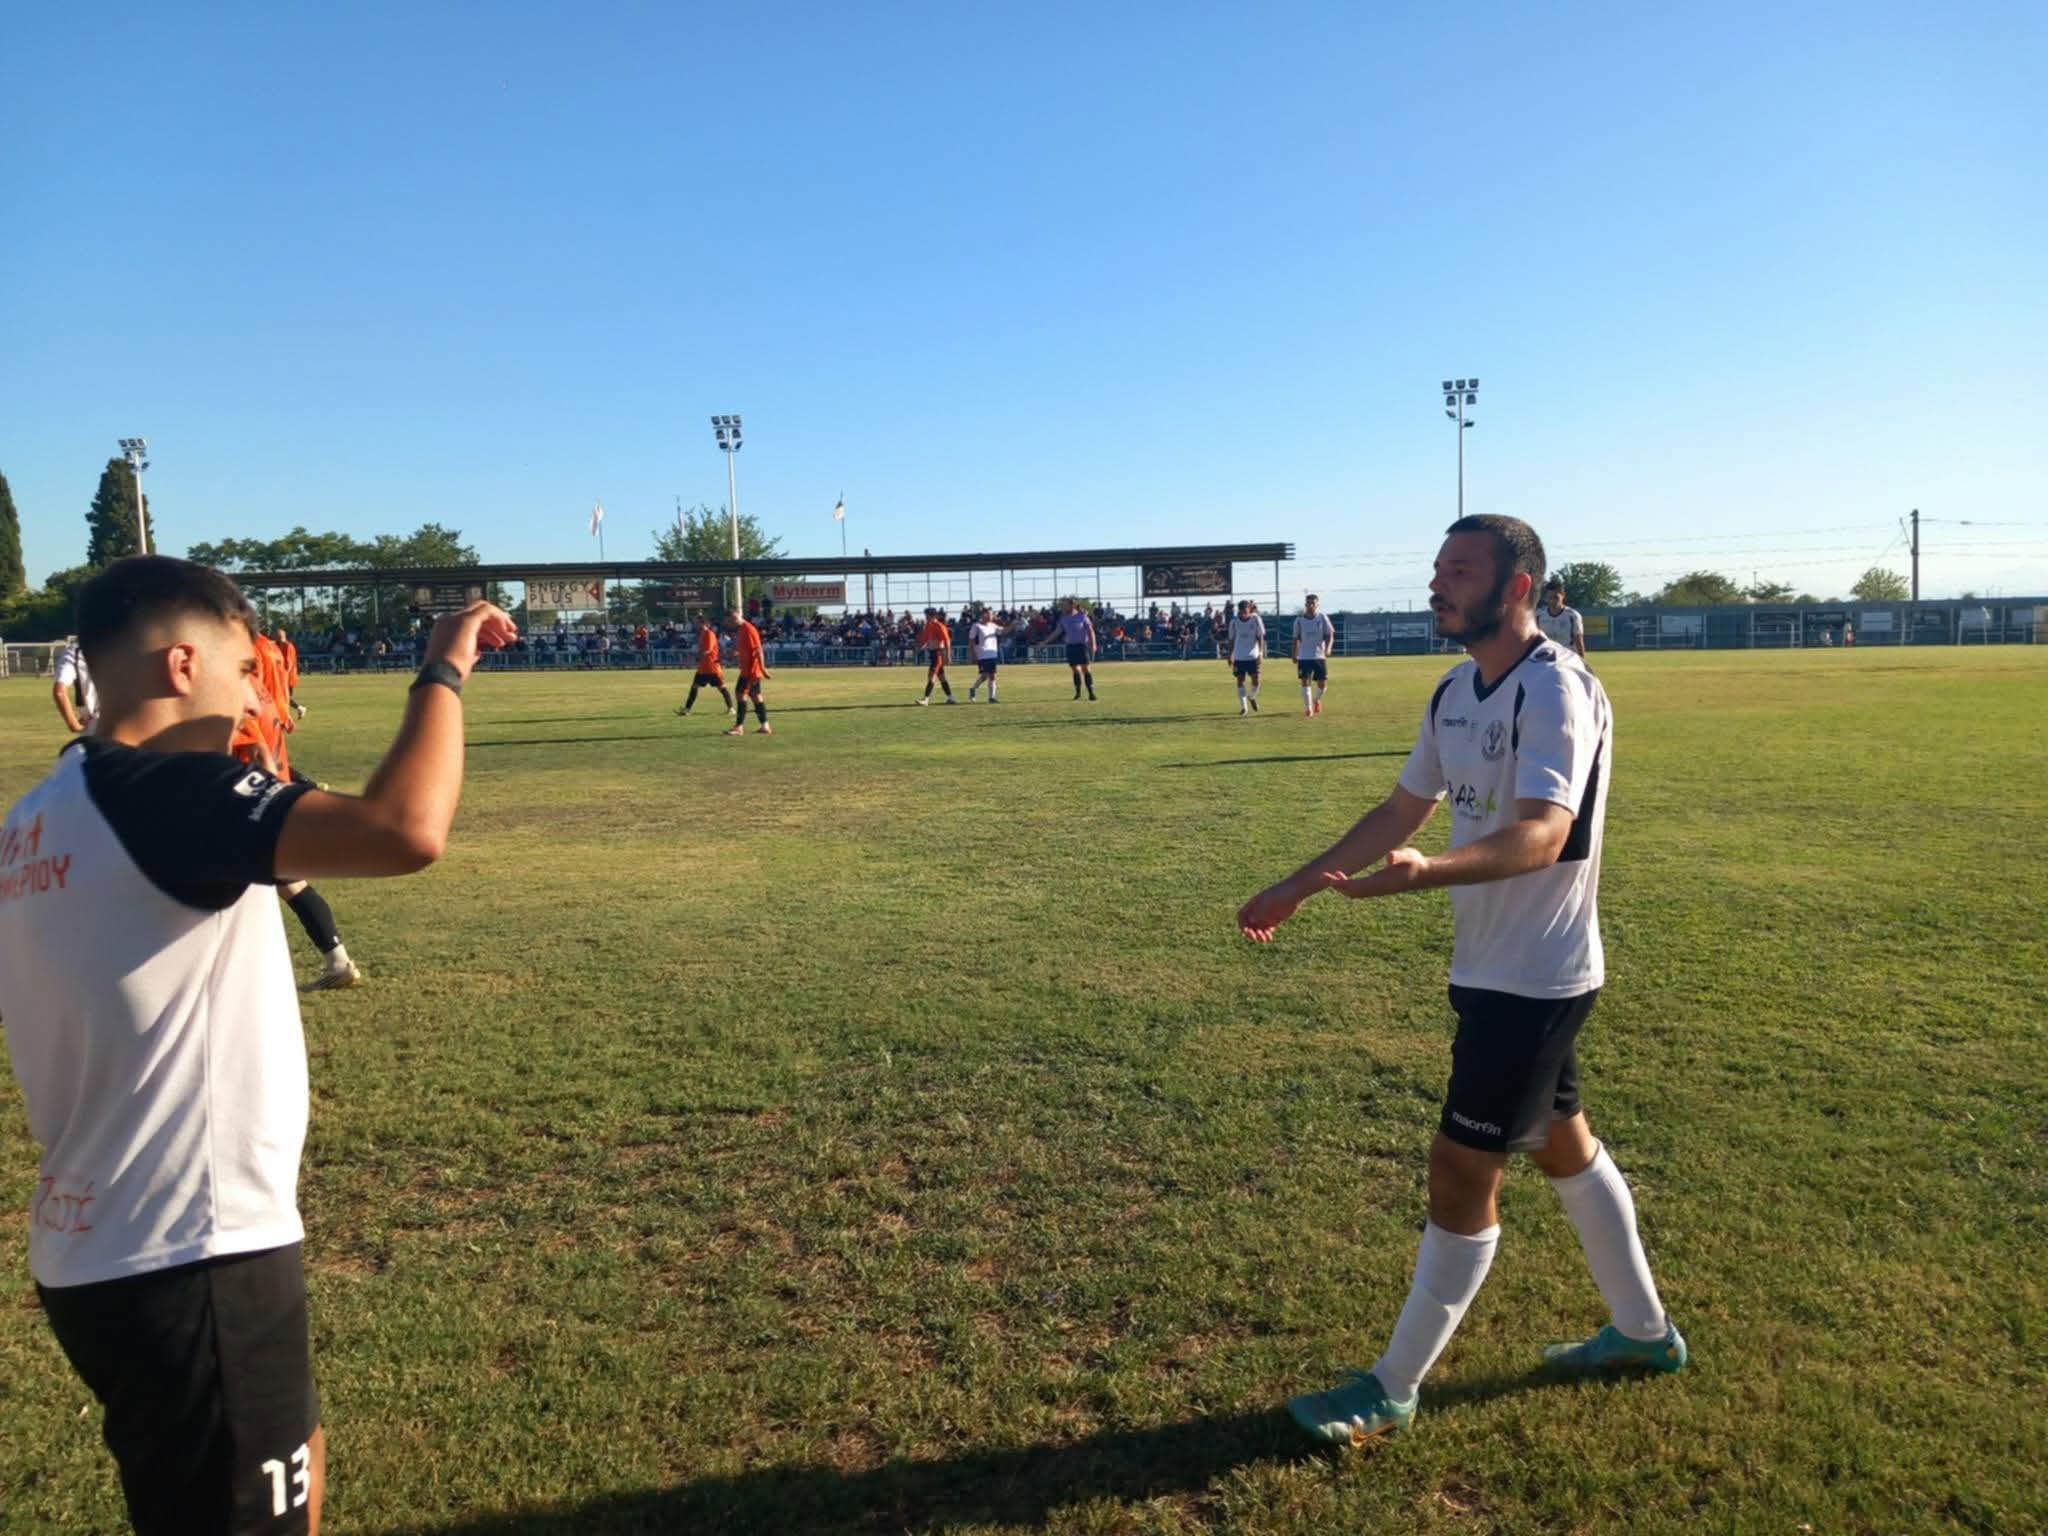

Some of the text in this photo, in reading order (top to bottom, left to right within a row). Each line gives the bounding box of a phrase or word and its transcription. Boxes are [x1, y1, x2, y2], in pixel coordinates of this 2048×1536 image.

[529, 581, 591, 593] ENERGY
[773, 583, 841, 600] Mytherm
[529, 592, 573, 604] PLUS
[261, 1443, 310, 1517] 13
